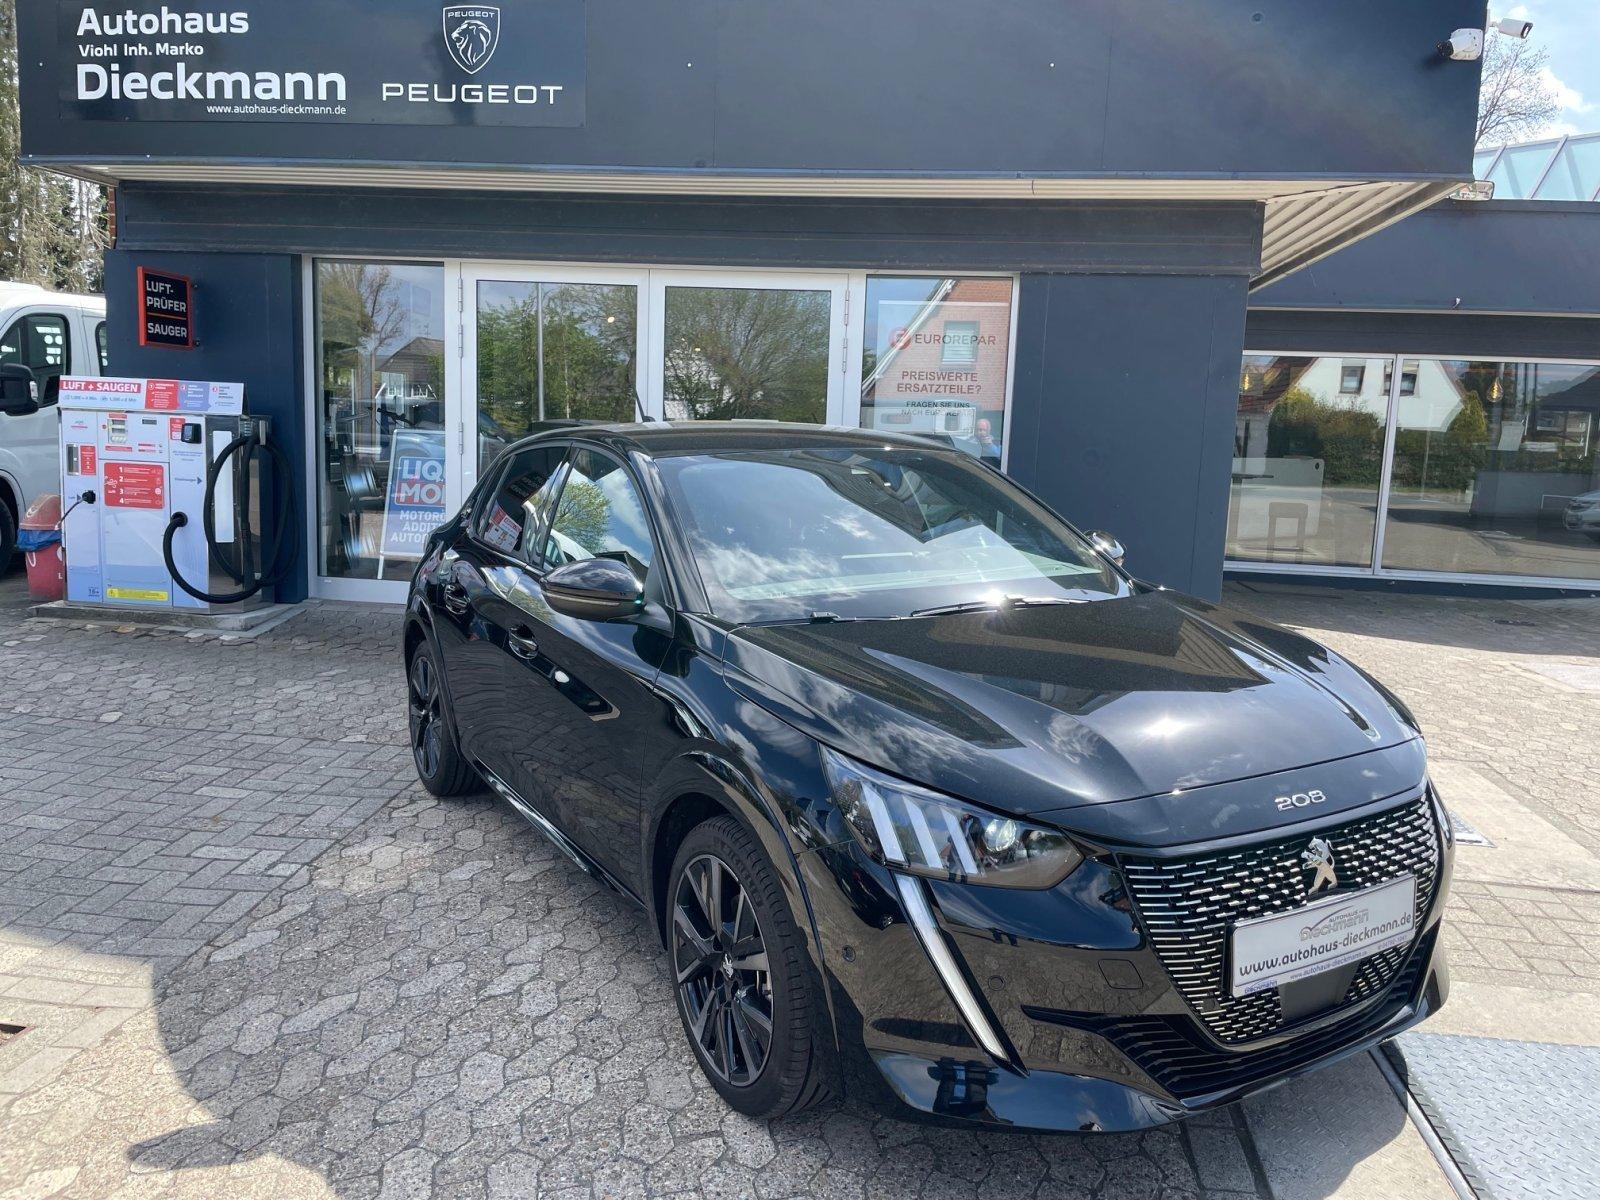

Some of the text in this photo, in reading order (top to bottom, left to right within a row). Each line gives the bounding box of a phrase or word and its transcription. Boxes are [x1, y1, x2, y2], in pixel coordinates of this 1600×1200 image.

[76, 6, 249, 36] Autohaus
[447, 10, 496, 18] PEUGEOT
[78, 42, 204, 57] Viohl Inh. Marko
[76, 62, 347, 101] Dieckmann
[382, 83, 563, 105] PEUGEOT
[206, 103, 347, 116] www.autohaus-dieckmann.de
[146, 280, 174, 295] LUFT-
[146, 296, 187, 313] PRÜFER
[147, 322, 188, 338] SAUGER
[915, 333, 997, 346] EUROREPAR
[901, 370, 978, 382] PREISWERTE
[62, 381, 86, 390] LUFT
[96, 382, 138, 392] SAUGEN
[897, 382, 982, 395] ERSATZTEILE?
[402, 459, 446, 482] LIQ
[402, 521, 443, 533] ADDIT
[1274, 789, 1326, 811] 208
[1328, 910, 1359, 923] AUTOHAUS
[1239, 912, 1413, 976] www.autohaus-dieckmann.de
